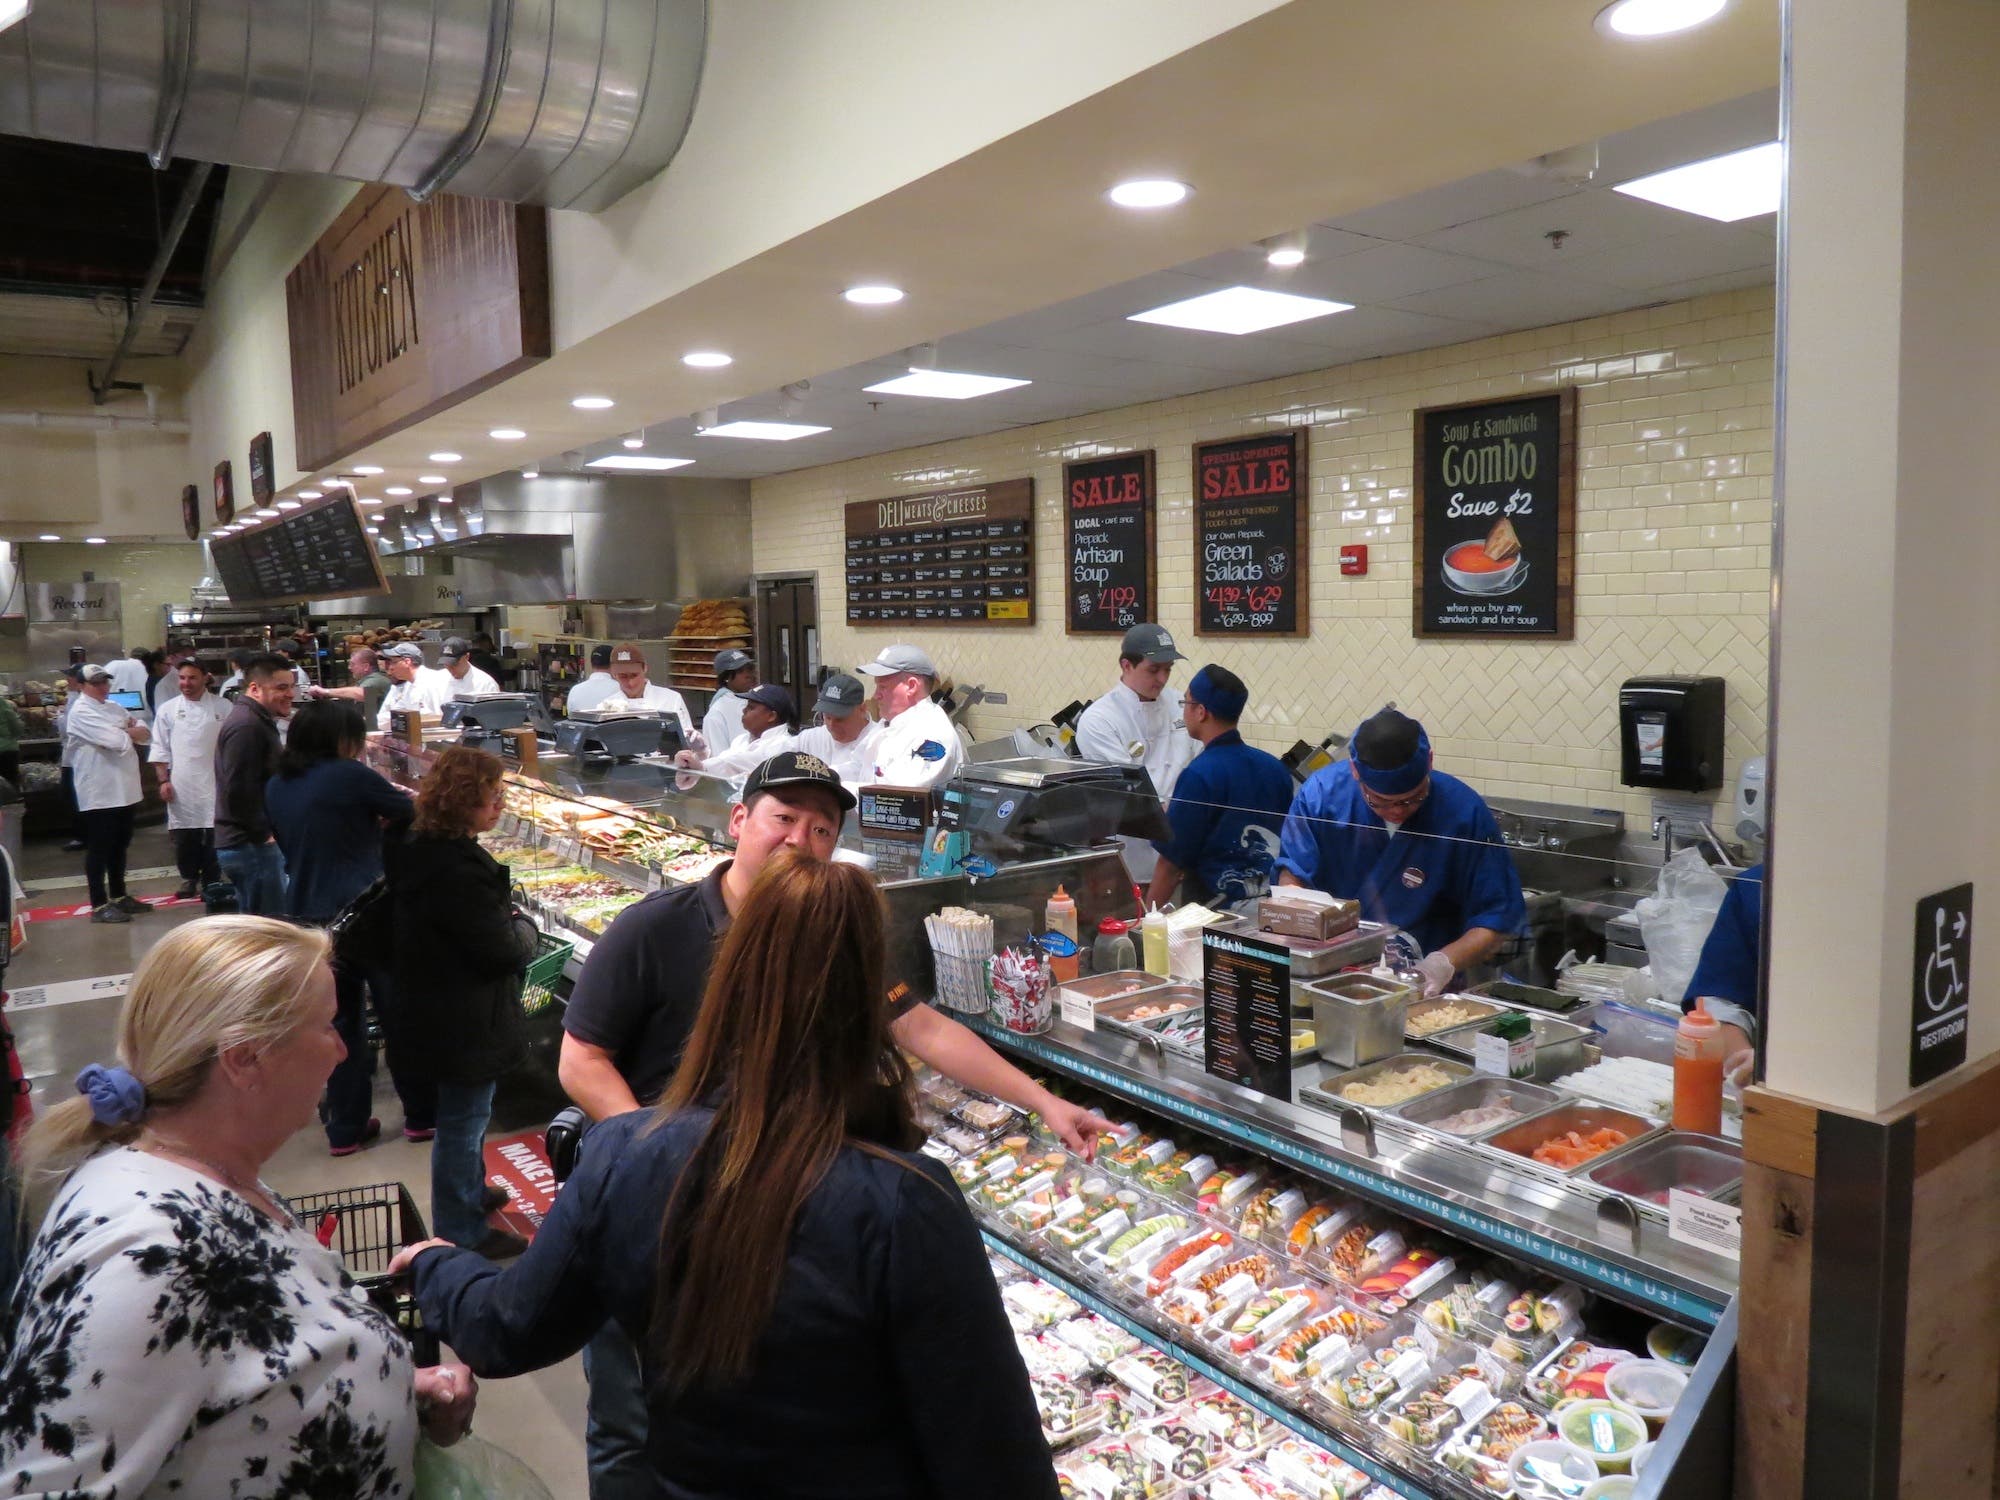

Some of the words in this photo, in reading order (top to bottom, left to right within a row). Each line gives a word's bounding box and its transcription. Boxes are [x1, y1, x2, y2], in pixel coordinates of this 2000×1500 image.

[334, 208, 419, 395] KITCHEN
[1442, 424, 1469, 443] Soup
[1472, 419, 1481, 439] &
[1484, 412, 1538, 438] Sandwich
[1203, 450, 1242, 466] SPECIAL
[1243, 445, 1289, 460] OPENING
[1442, 437, 1538, 488] Combo
[1072, 472, 1141, 508] SALE
[1204, 459, 1290, 500] SALE
[879, 500, 903, 529] DELI
[904, 503, 932, 520] MEATS
[947, 496, 987, 515] CHEESES
[1447, 492, 1499, 519] Save
[1503, 488, 1533, 517] $2
[1074, 518, 1101, 529] LOCAL
[1074, 532, 1109, 547] Prepack
[1219, 532, 1236, 540] Own
[1074, 547, 1124, 564] Artisan
[1205, 543, 1253, 562] Green
[1074, 567, 1109, 587] Soup
[1205, 561, 1263, 582] Salads
[52, 595, 106, 610] Revent
[1446, 604, 1469, 613] when
[1471, 605, 1486, 615] you
[1488, 603, 1504, 614] buy
[1506, 604, 1523, 614] any
[1438, 615, 1478, 625] sandwich
[1481, 615, 1498, 625] and
[1501, 615, 1516, 624] hot
[1517, 616, 1538, 626] soup
[1920, 1018, 1965, 1050] RESTROOM
[1168, 1098, 1185, 1111] For
[1191, 1106, 1210, 1121] You
[498, 1143, 554, 1181] MAKE
[1270, 1135, 1304, 1161] Party
[1312, 1152, 1341, 1173] Tray
[1348, 1169, 1374, 1185] And
[1382, 1180, 1450, 1219] Catering
[1458, 1210, 1541, 1251] Available
[1599, 1264, 1632, 1287] Ask
